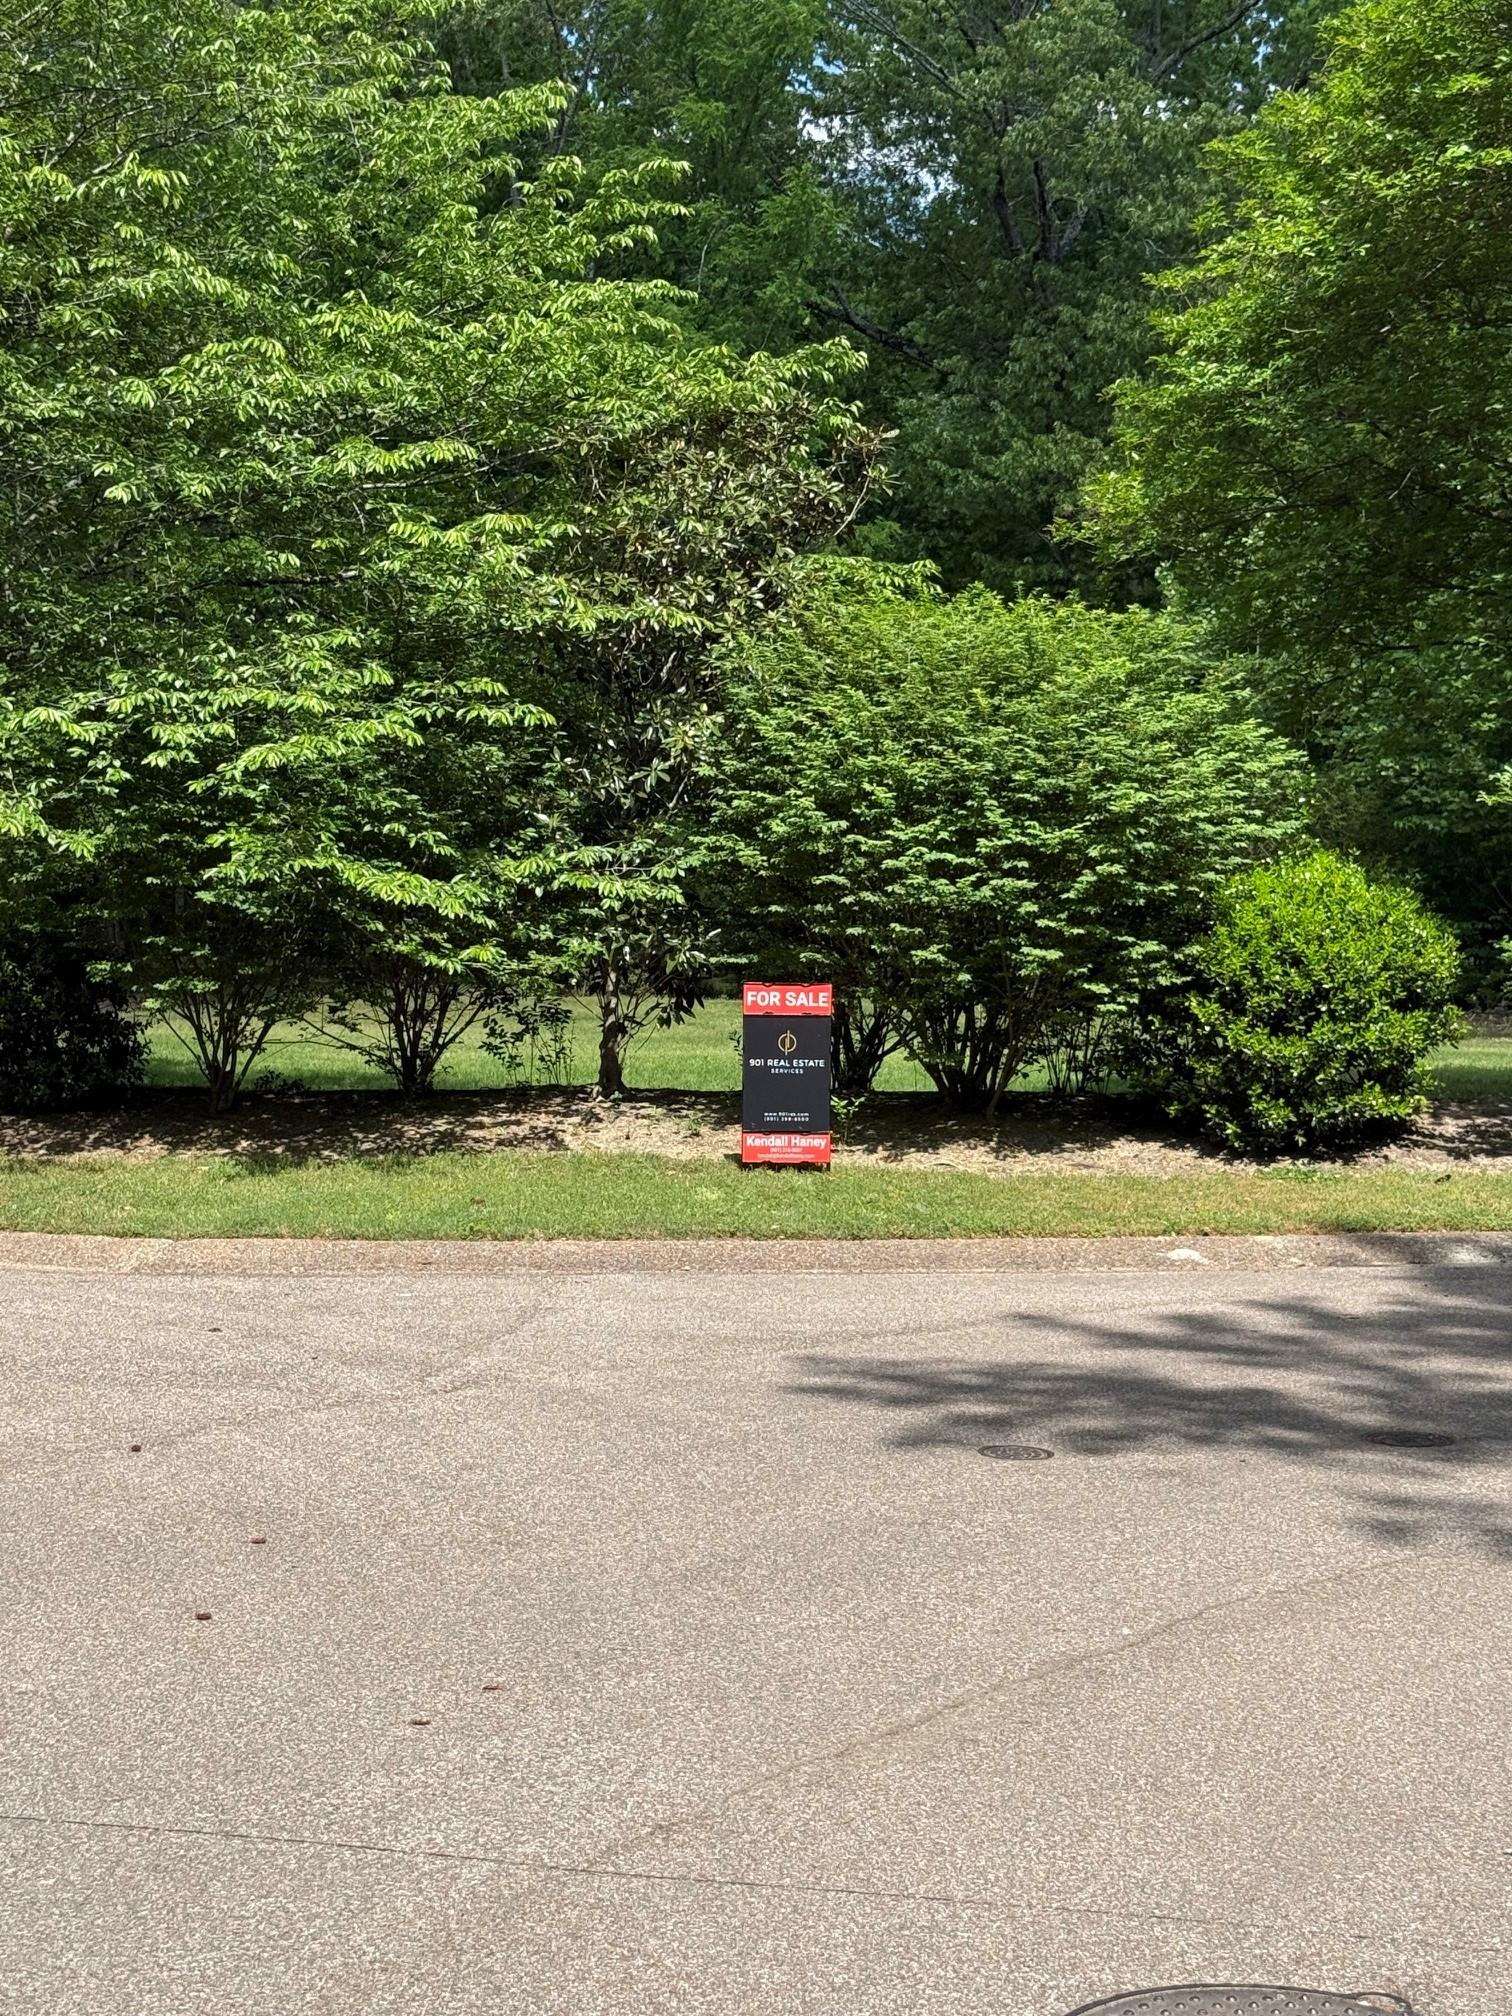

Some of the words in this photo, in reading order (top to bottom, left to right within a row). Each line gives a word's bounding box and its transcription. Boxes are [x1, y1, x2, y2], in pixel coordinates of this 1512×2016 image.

[746, 991, 780, 1007] FOR
[786, 991, 829, 1008] SALE
[749, 1059, 765, 1067] 901
[767, 1059, 789, 1067] REAL
[793, 1059, 825, 1068] ESTATE
[746, 1135, 787, 1147] Kendall
[791, 1135, 827, 1148] Haney
